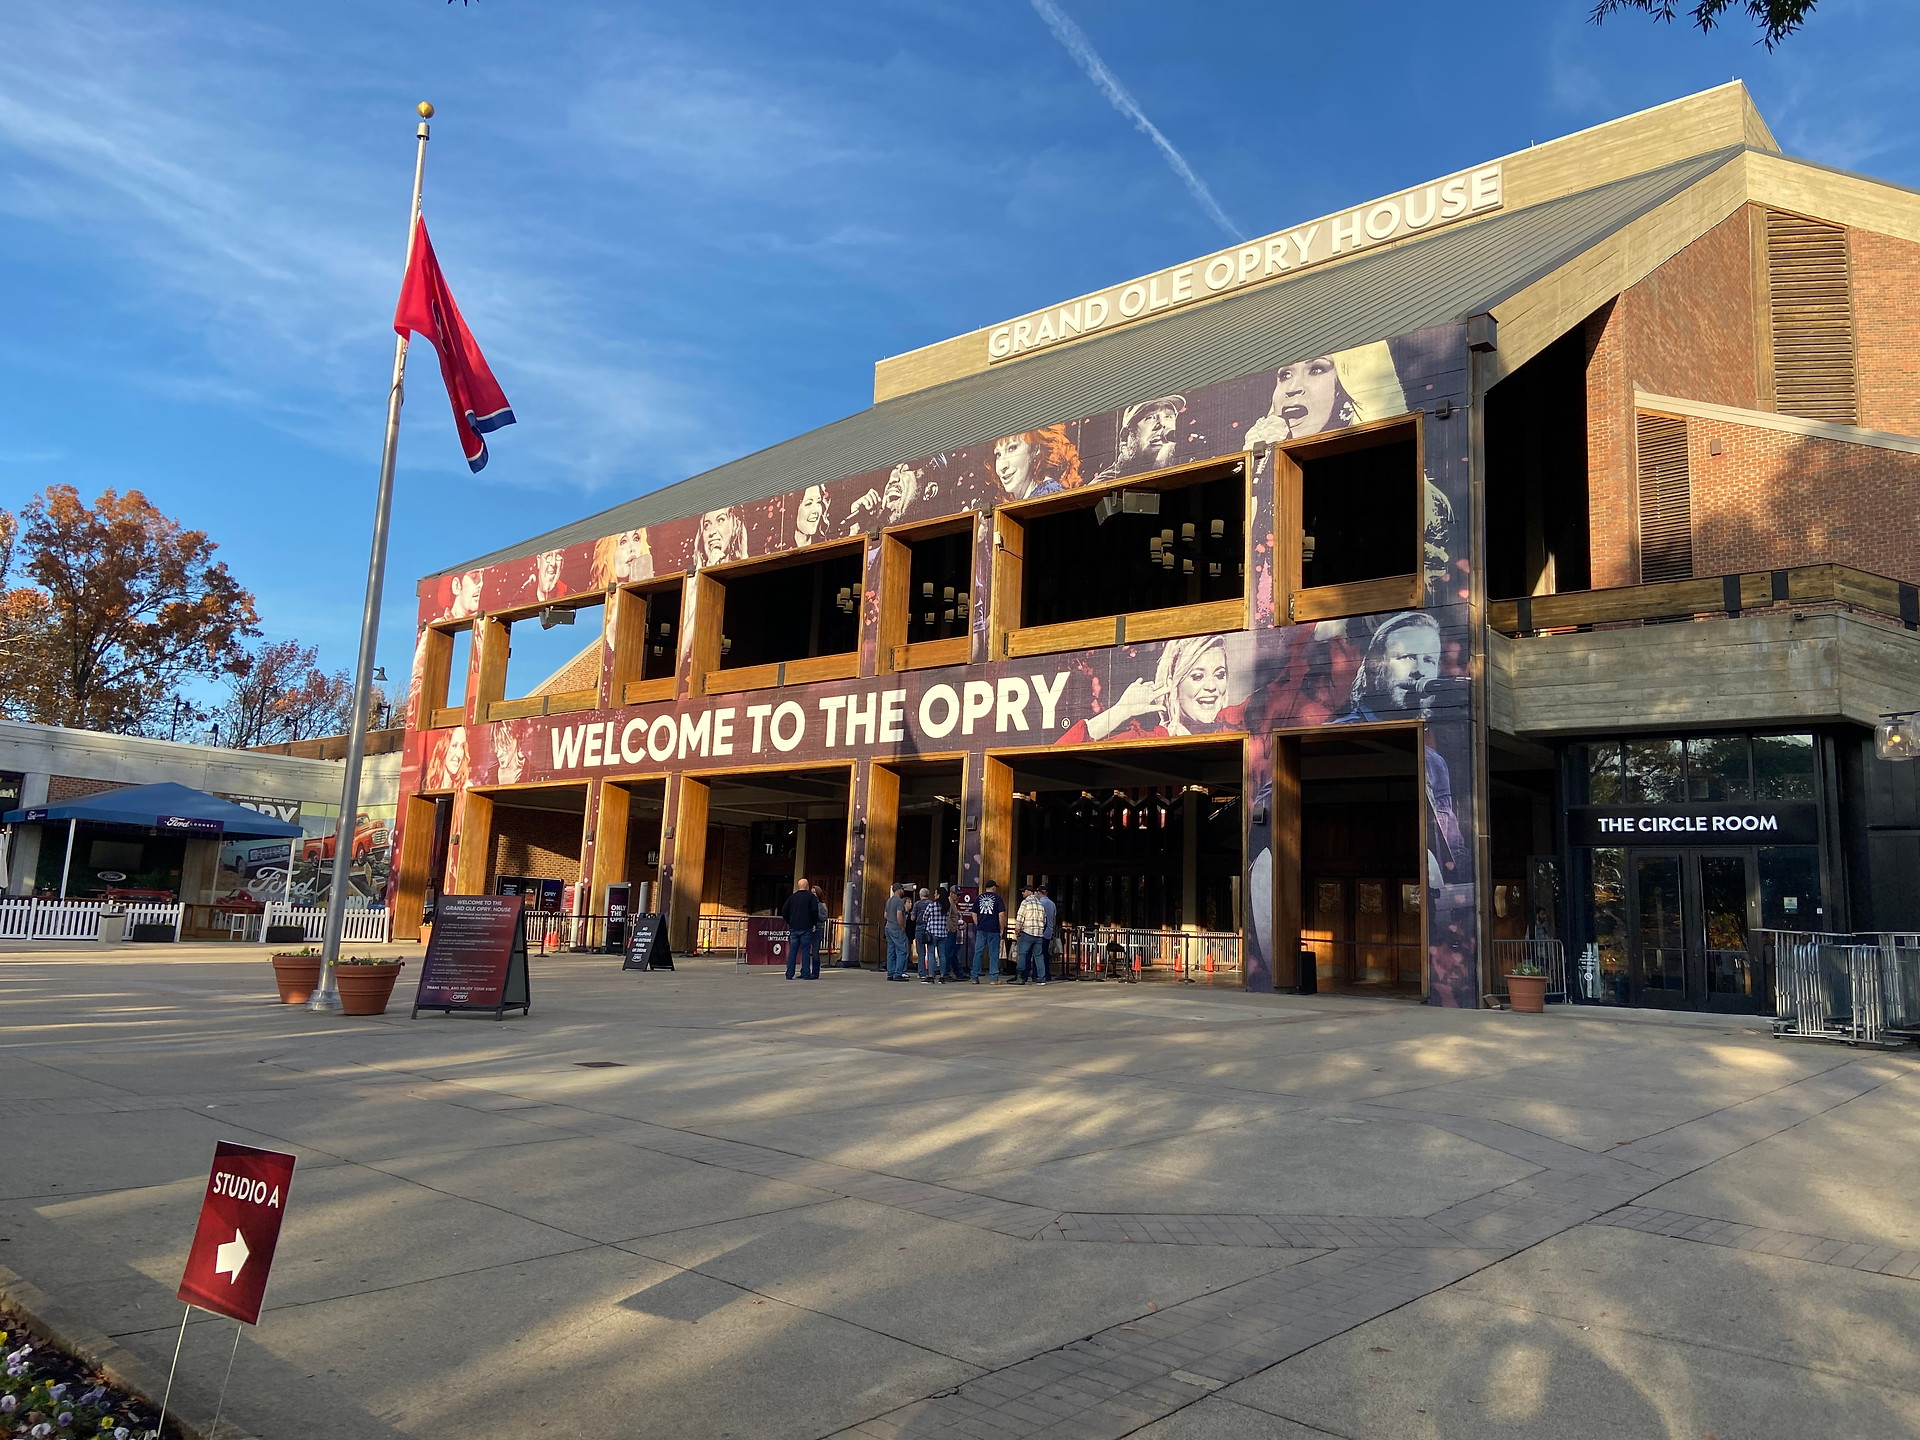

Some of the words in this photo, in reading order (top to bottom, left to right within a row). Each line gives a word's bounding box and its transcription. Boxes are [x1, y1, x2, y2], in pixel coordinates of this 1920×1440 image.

[988, 296, 1109, 359] GRAND
[1118, 266, 1195, 319] OLE
[1204, 224, 1320, 291] OPRY
[1331, 164, 1500, 255] HOUSE
[551, 707, 736, 770] WELCOME
[746, 700, 806, 754] TO
[818, 688, 907, 748] THE
[166, 816, 190, 828] Ford
[1597, 817, 1635, 833] THE
[1638, 816, 1708, 832] CIRCLE
[1712, 815, 1778, 832] ROOM
[247, 866, 319, 896] Ford
[213, 1172, 267, 1204] STUDIO
[267, 1184, 279, 1209] A
